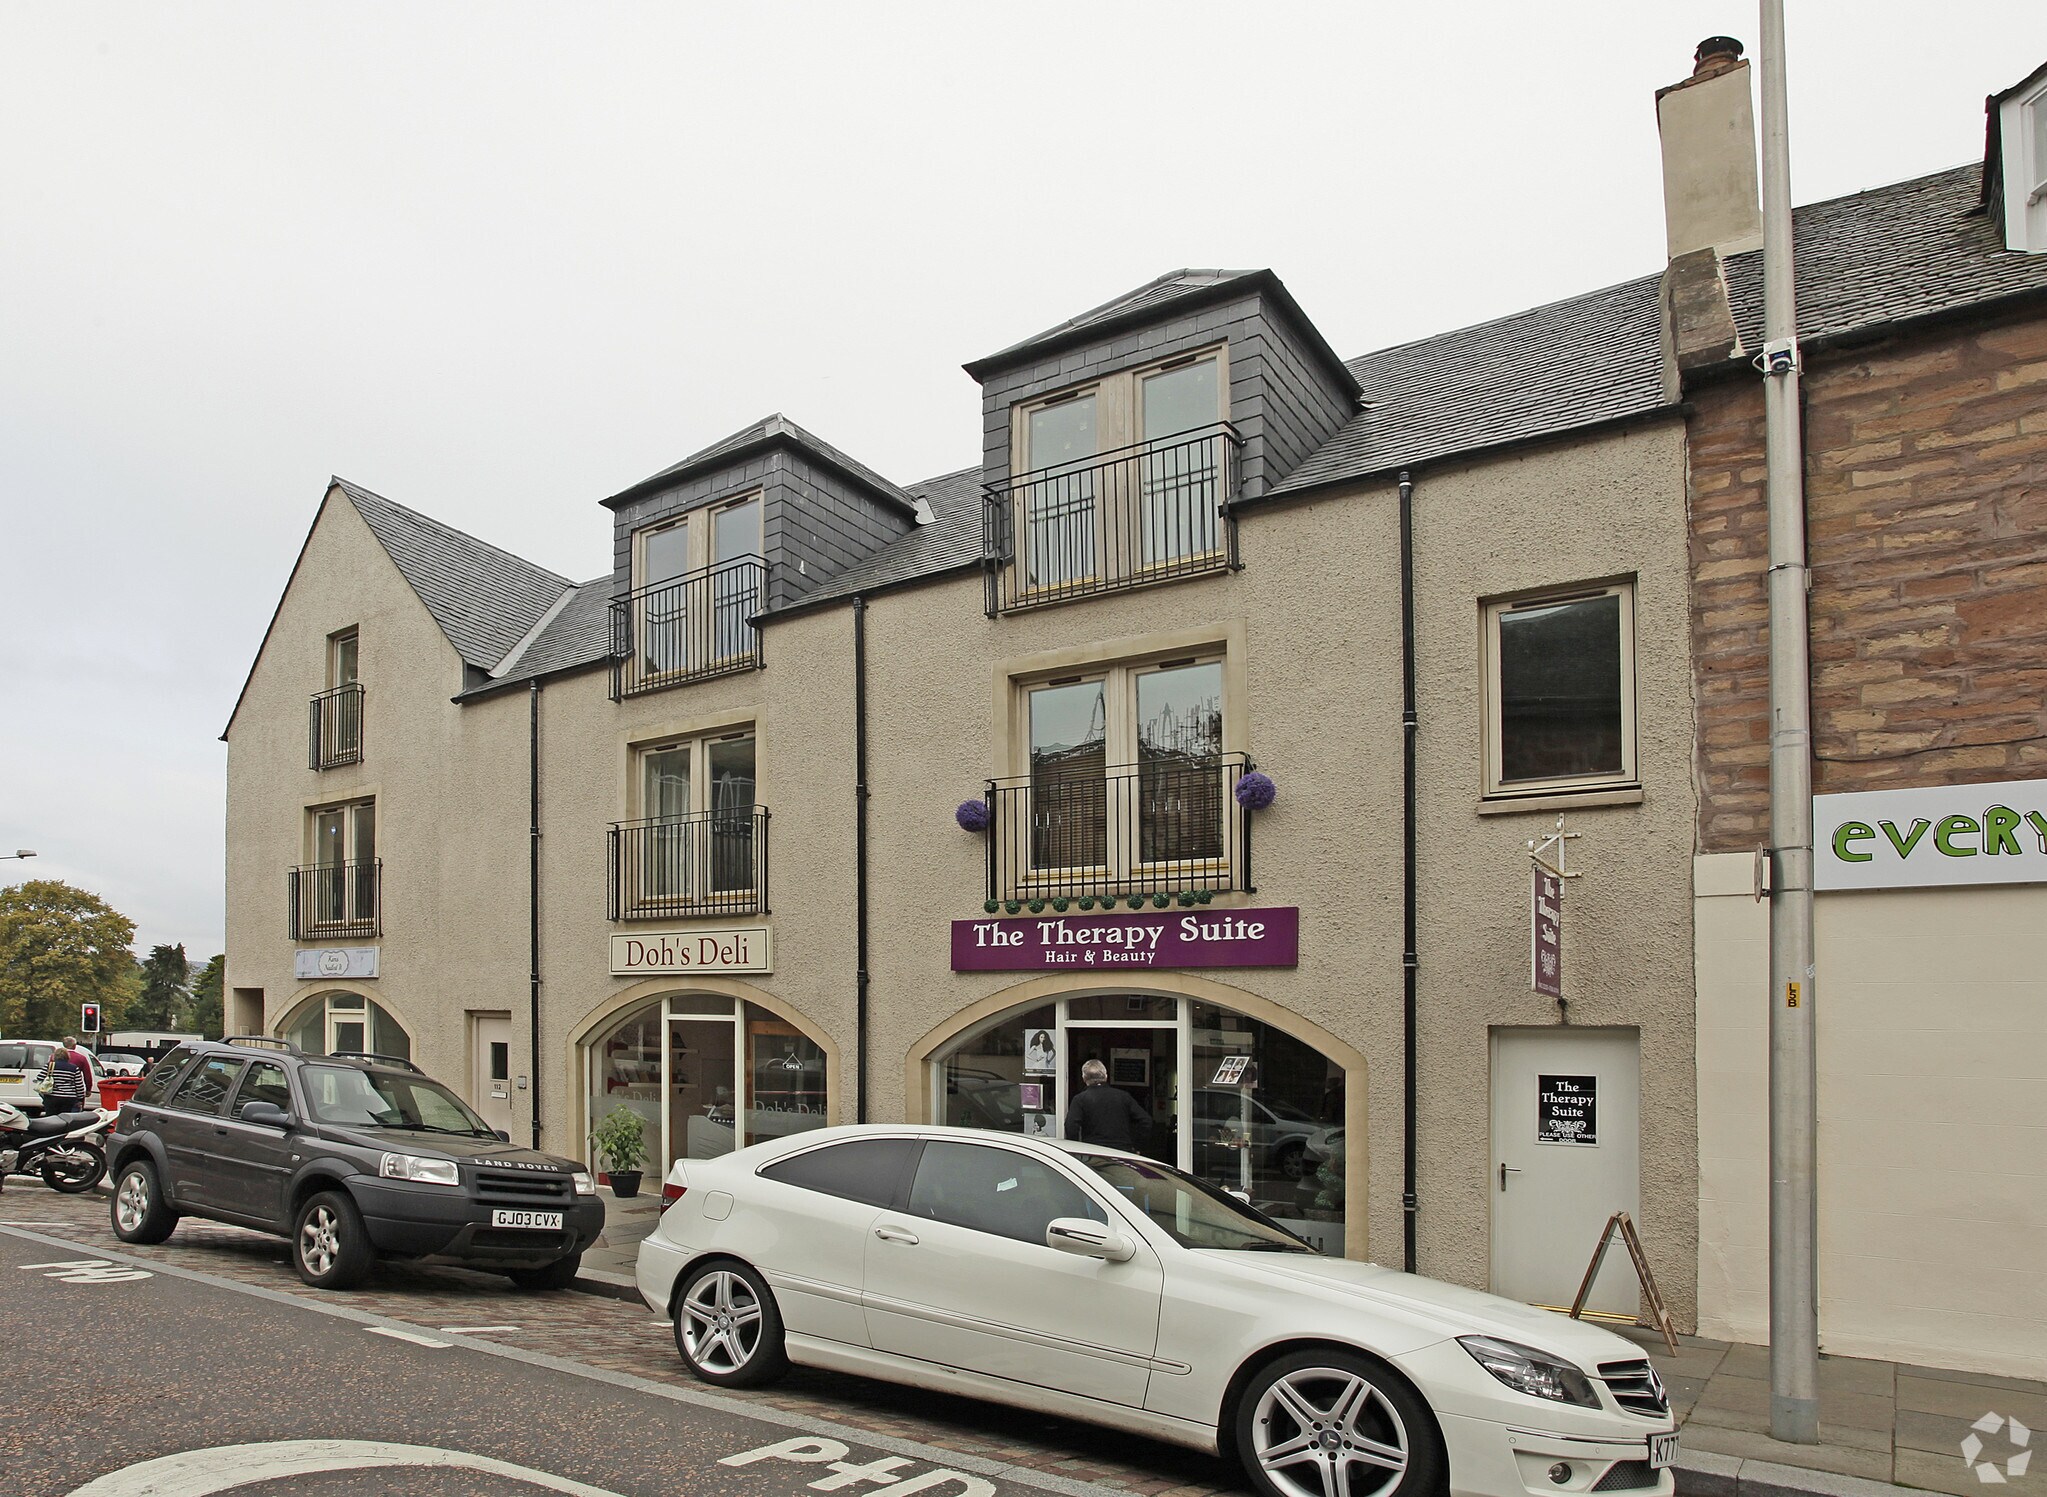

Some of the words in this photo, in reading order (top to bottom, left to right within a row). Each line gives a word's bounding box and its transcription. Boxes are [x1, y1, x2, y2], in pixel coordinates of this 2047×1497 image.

[972, 921, 1024, 947] The
[1037, 918, 1164, 950] Therapy
[1179, 915, 1266, 942] Suite
[625, 936, 691, 967] Doh's
[697, 934, 750, 966] Deli
[1045, 950, 1078, 964] Hair
[1084, 949, 1096, 965] &
[1102, 949, 1156, 965] Beauty
[1555, 1080, 1580, 1093] The
[1541, 1092, 1595, 1107] Therapy
[1551, 1105, 1584, 1117] Suite
[474, 1158, 512, 1168] LAND
[518, 1162, 559, 1172] ROVER
[498, 1211, 532, 1226] GJ03
[534, 1213, 558, 1227] CVX
